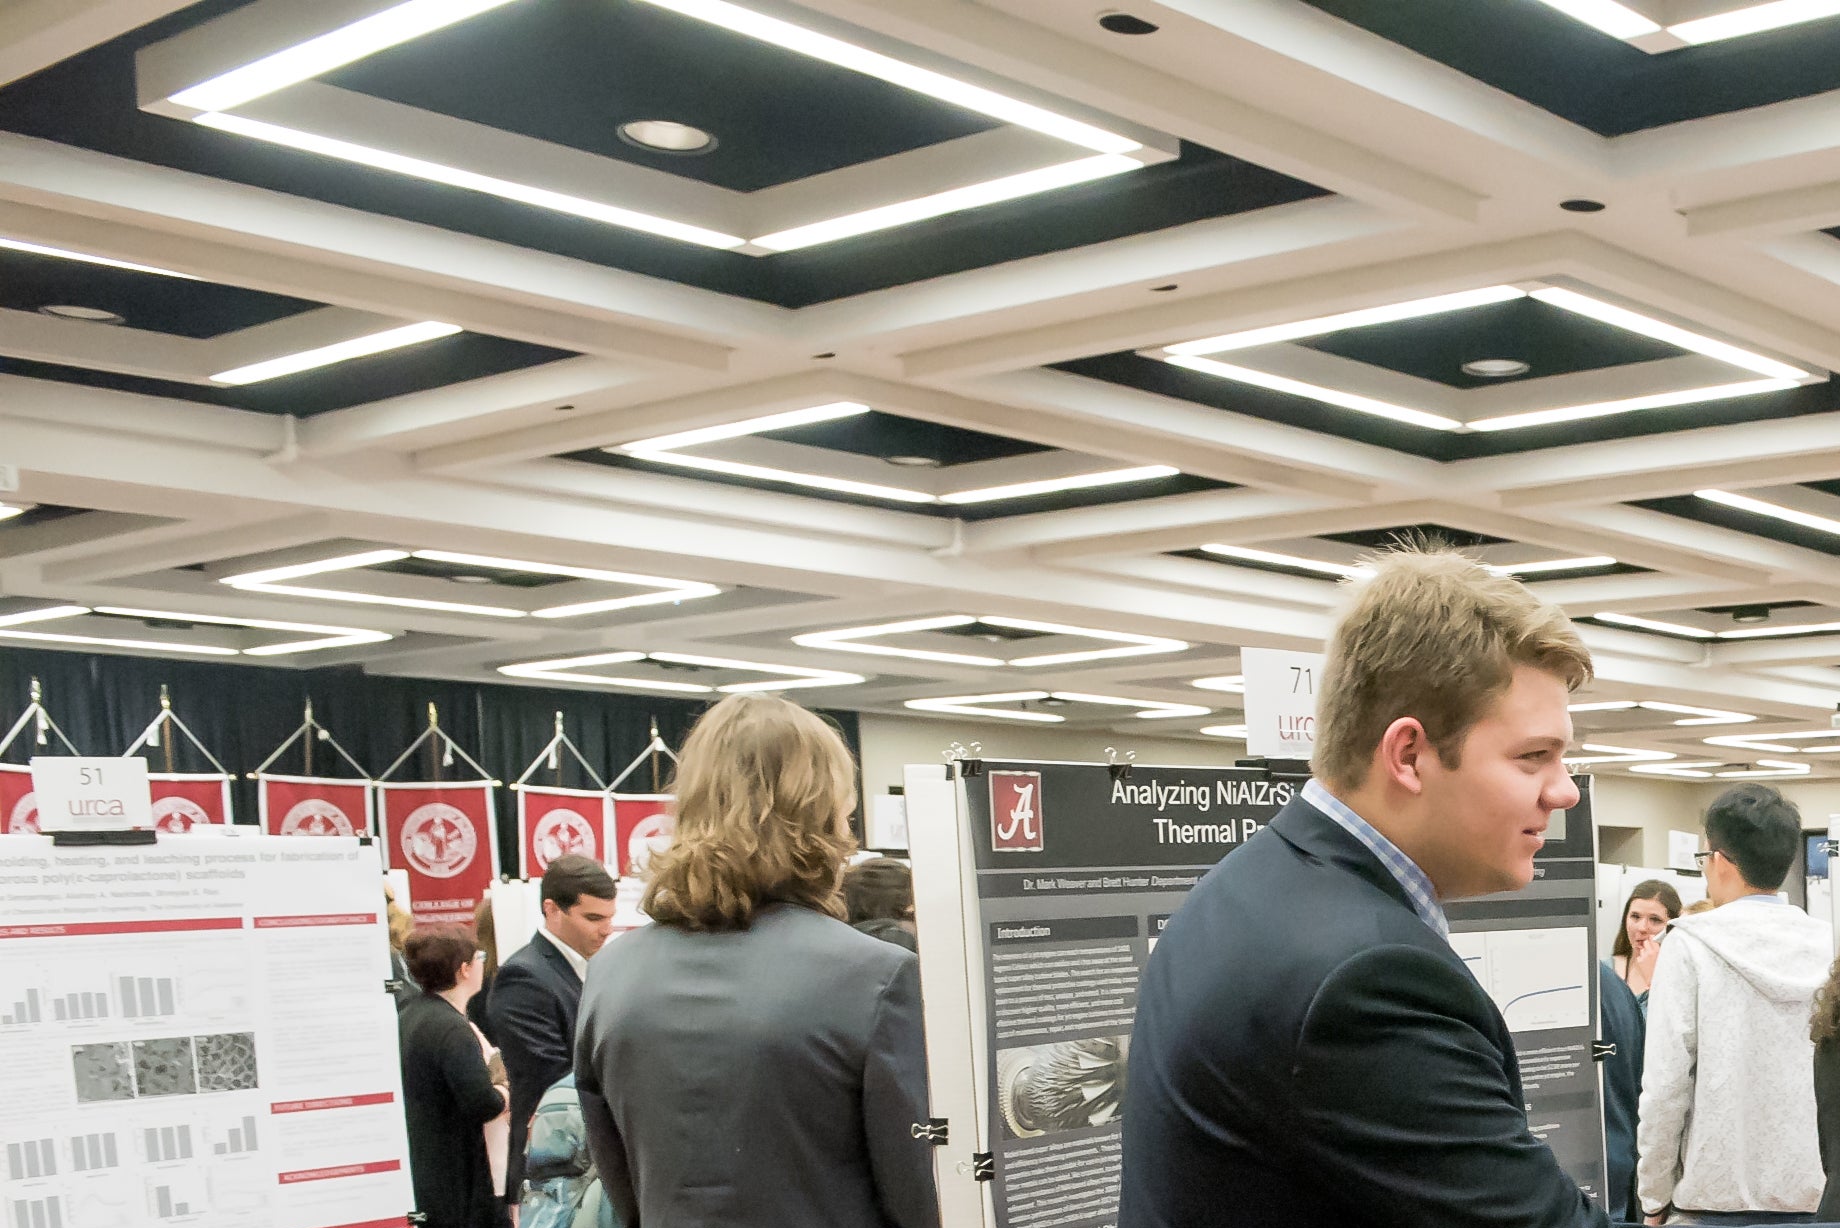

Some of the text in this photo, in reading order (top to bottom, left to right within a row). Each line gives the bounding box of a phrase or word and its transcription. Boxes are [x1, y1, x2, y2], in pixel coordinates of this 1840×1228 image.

[1289, 666, 1313, 695] 71
[1278, 714, 1316, 742] urc
[79, 766, 104, 786] 51
[67, 798, 126, 817] urca
[1110, 779, 1211, 813] Analyzing
[1152, 817, 1266, 844] Thermal Pr
[115, 855, 139, 866] and
[205, 853, 256, 867] process
[260, 851, 277, 862] for
